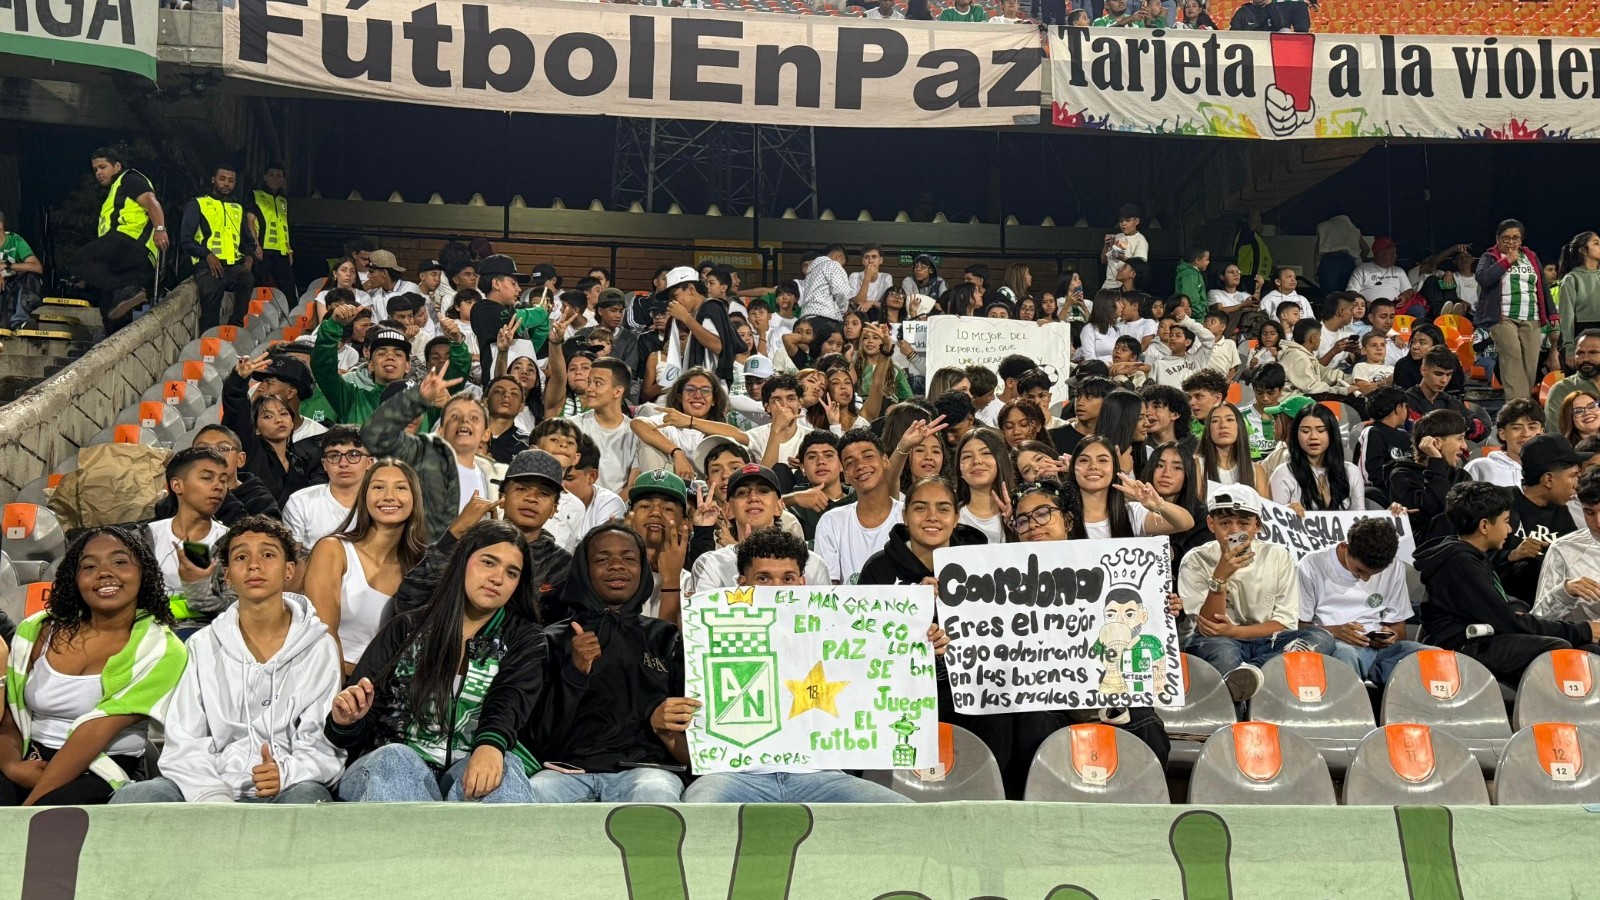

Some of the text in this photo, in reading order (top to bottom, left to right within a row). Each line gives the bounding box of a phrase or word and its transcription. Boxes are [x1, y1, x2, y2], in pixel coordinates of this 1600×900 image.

[1058, 25, 1256, 101] Tarjeta
[1328, 44, 1361, 98] a
[1379, 35, 1434, 98] la
[1010, 331, 1029, 341] DEL
[938, 553, 1105, 608] Cardona
[794, 614, 821, 634] En
[851, 614, 877, 633] de
[944, 607, 1095, 641] Eres el mejor
[822, 638, 867, 661] PAZ
[946, 637, 1118, 670] Sigo admirandote
[1166, 633, 1179, 670] una
[866, 658, 895, 680] SE
[950, 669, 972, 686] en
[977, 665, 1006, 687] las
[1011, 667, 1089, 687] buenas
[806, 685, 819, 700] 18
[1158, 672, 1179, 705] con
[1304, 690, 1314, 698] 11
[1568, 684, 1579, 692] 13
[873, 686, 936, 721] Juega
[953, 691, 975, 708] en
[980, 689, 1012, 708] las
[854, 710, 877, 731] EL
[810, 730, 877, 751] Futbol
[730, 752, 753, 768] de
[1091, 751, 1098, 761] 8
[1552, 748, 1566, 761] 12
[929, 767, 936, 775] 8
[1555, 767, 1568, 775] 12
